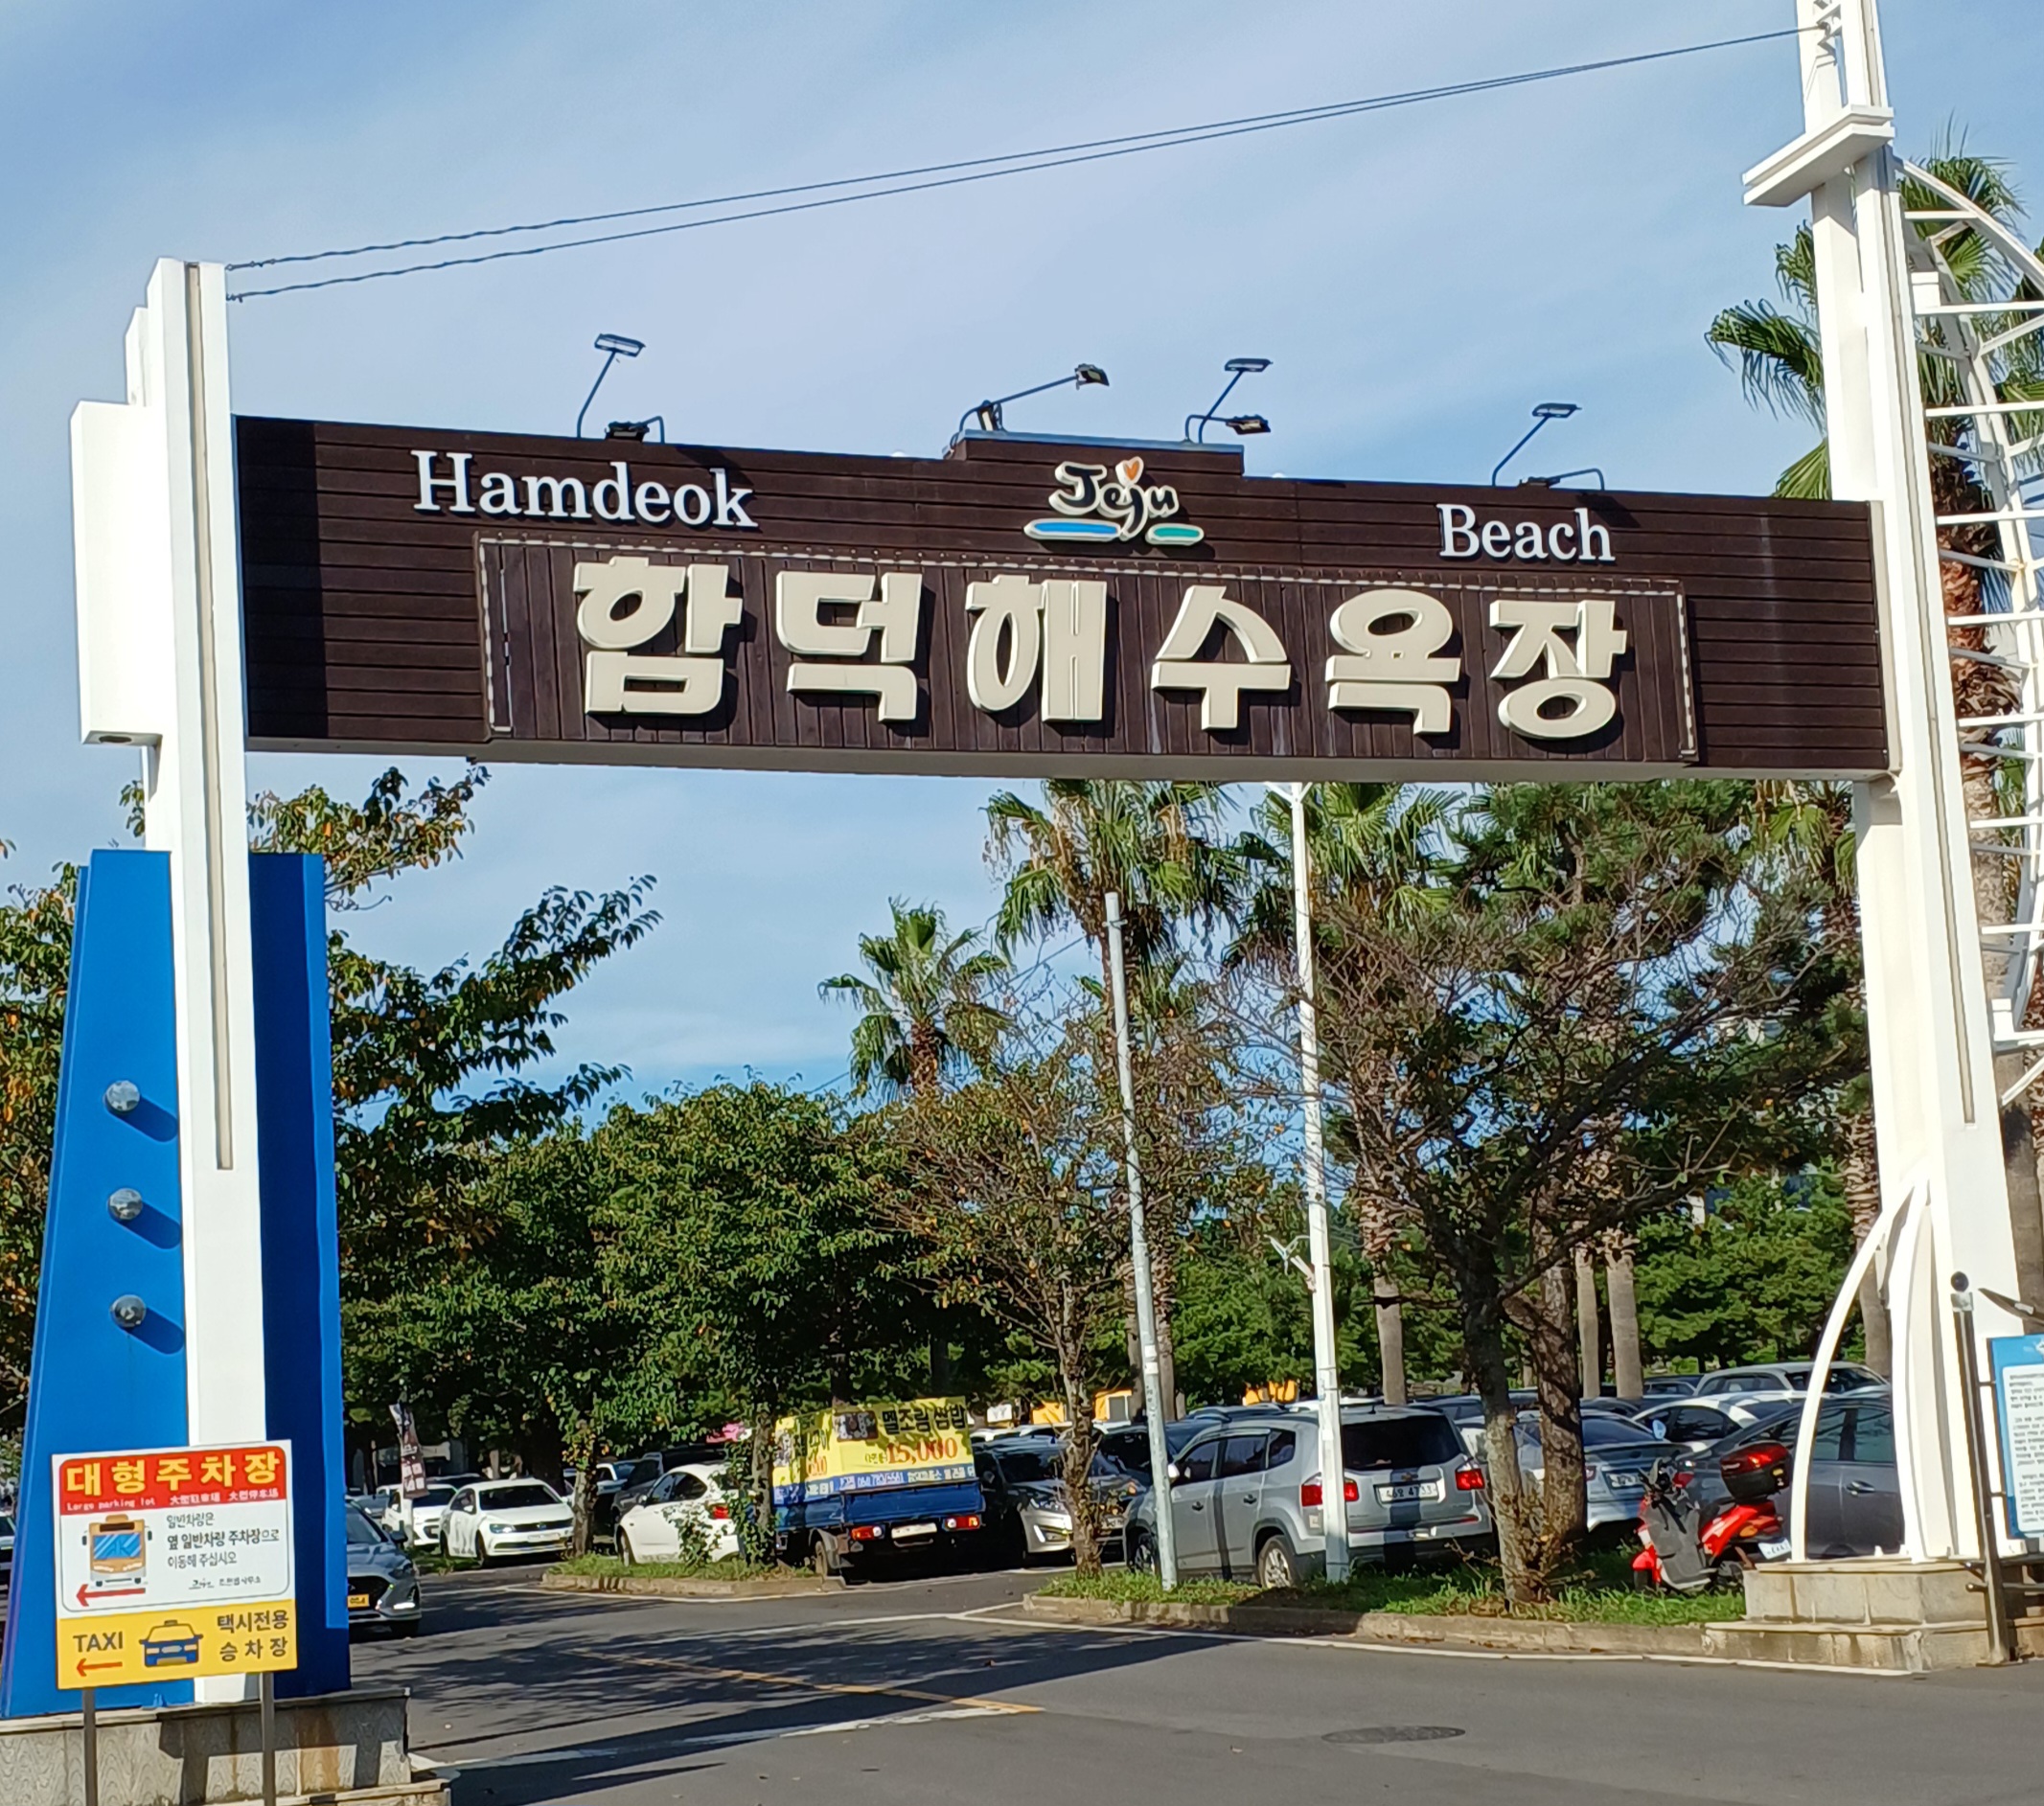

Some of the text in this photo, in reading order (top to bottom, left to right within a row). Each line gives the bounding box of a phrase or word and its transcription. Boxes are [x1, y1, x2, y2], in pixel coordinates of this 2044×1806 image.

[410, 449, 1617, 563] Hamdeok Beach
[1049, 457, 1180, 540] Jeju
[573, 556, 1627, 741] 함덕해수욕장
[66, 1451, 280, 1497] 대형주차장
[98, 1498, 136, 1510] parking
[141, 1497, 155, 1506] lot
[181, 1531, 225, 1549] 일반차량
[228, 1528, 280, 1545] 주차장으로
[217, 1610, 288, 1635] 택시전용
[73, 1632, 123, 1653] TAXI
